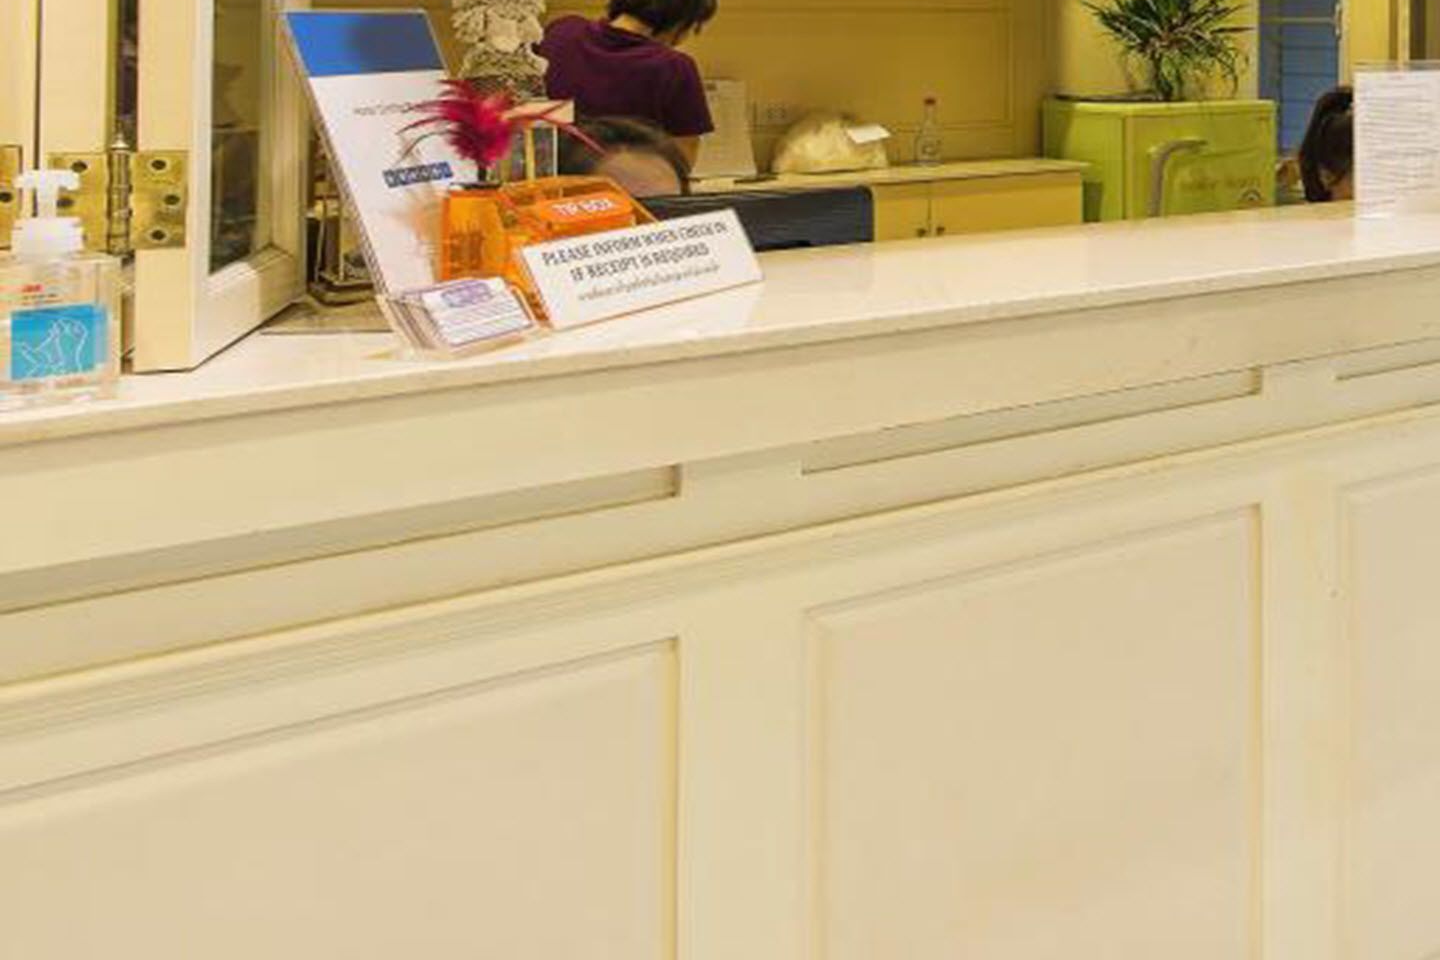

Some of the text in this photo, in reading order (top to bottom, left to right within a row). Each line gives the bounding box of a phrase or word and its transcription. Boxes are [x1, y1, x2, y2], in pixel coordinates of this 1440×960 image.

[542, 244, 592, 266] PLEASE
[592, 235, 642, 255] INFORM
[570, 266, 584, 281] IF
[585, 256, 639, 278] RECEIPT
